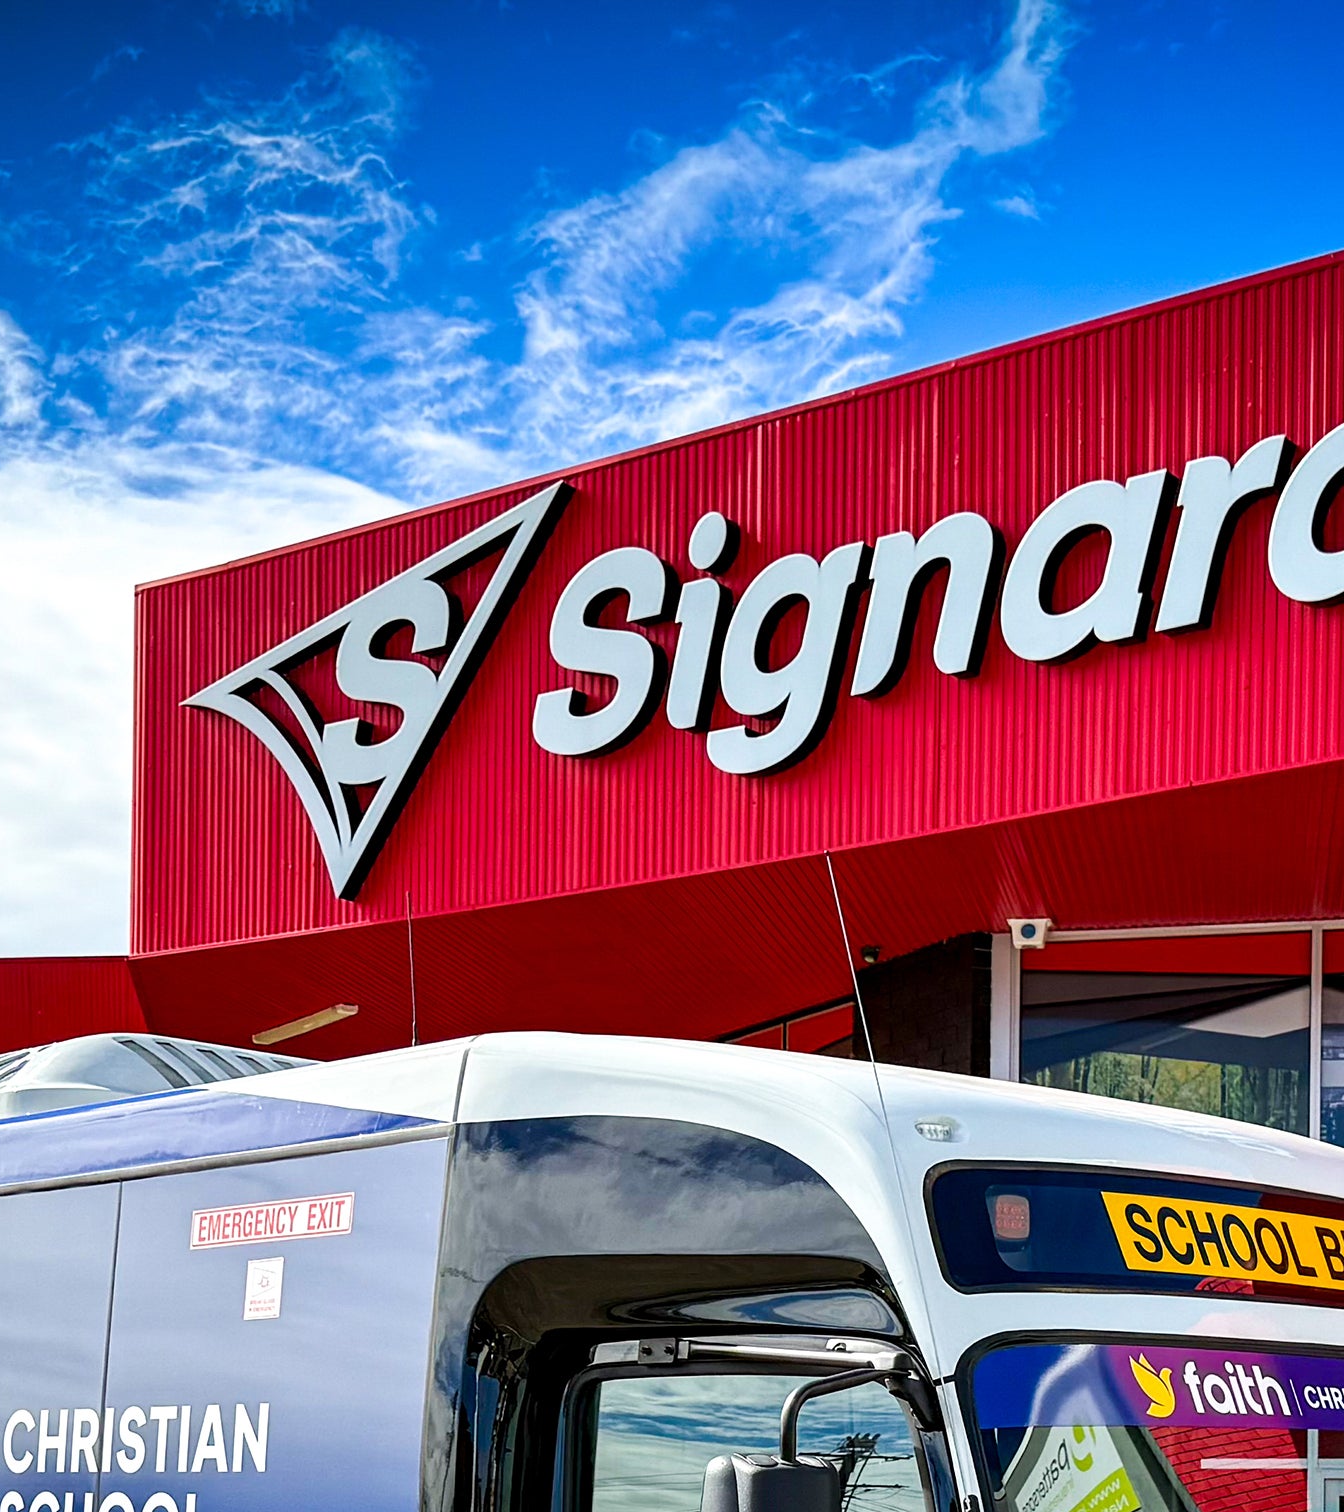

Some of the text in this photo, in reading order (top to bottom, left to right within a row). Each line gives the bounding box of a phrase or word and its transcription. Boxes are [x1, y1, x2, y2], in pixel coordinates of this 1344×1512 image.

[198, 1200, 346, 1242] EMERGENCY EXIT
[1123, 1202, 1318, 1279] SCHOOL
[1183, 1361, 1292, 1416] faith
[2, 1402, 270, 1474] CHRISTIAN
